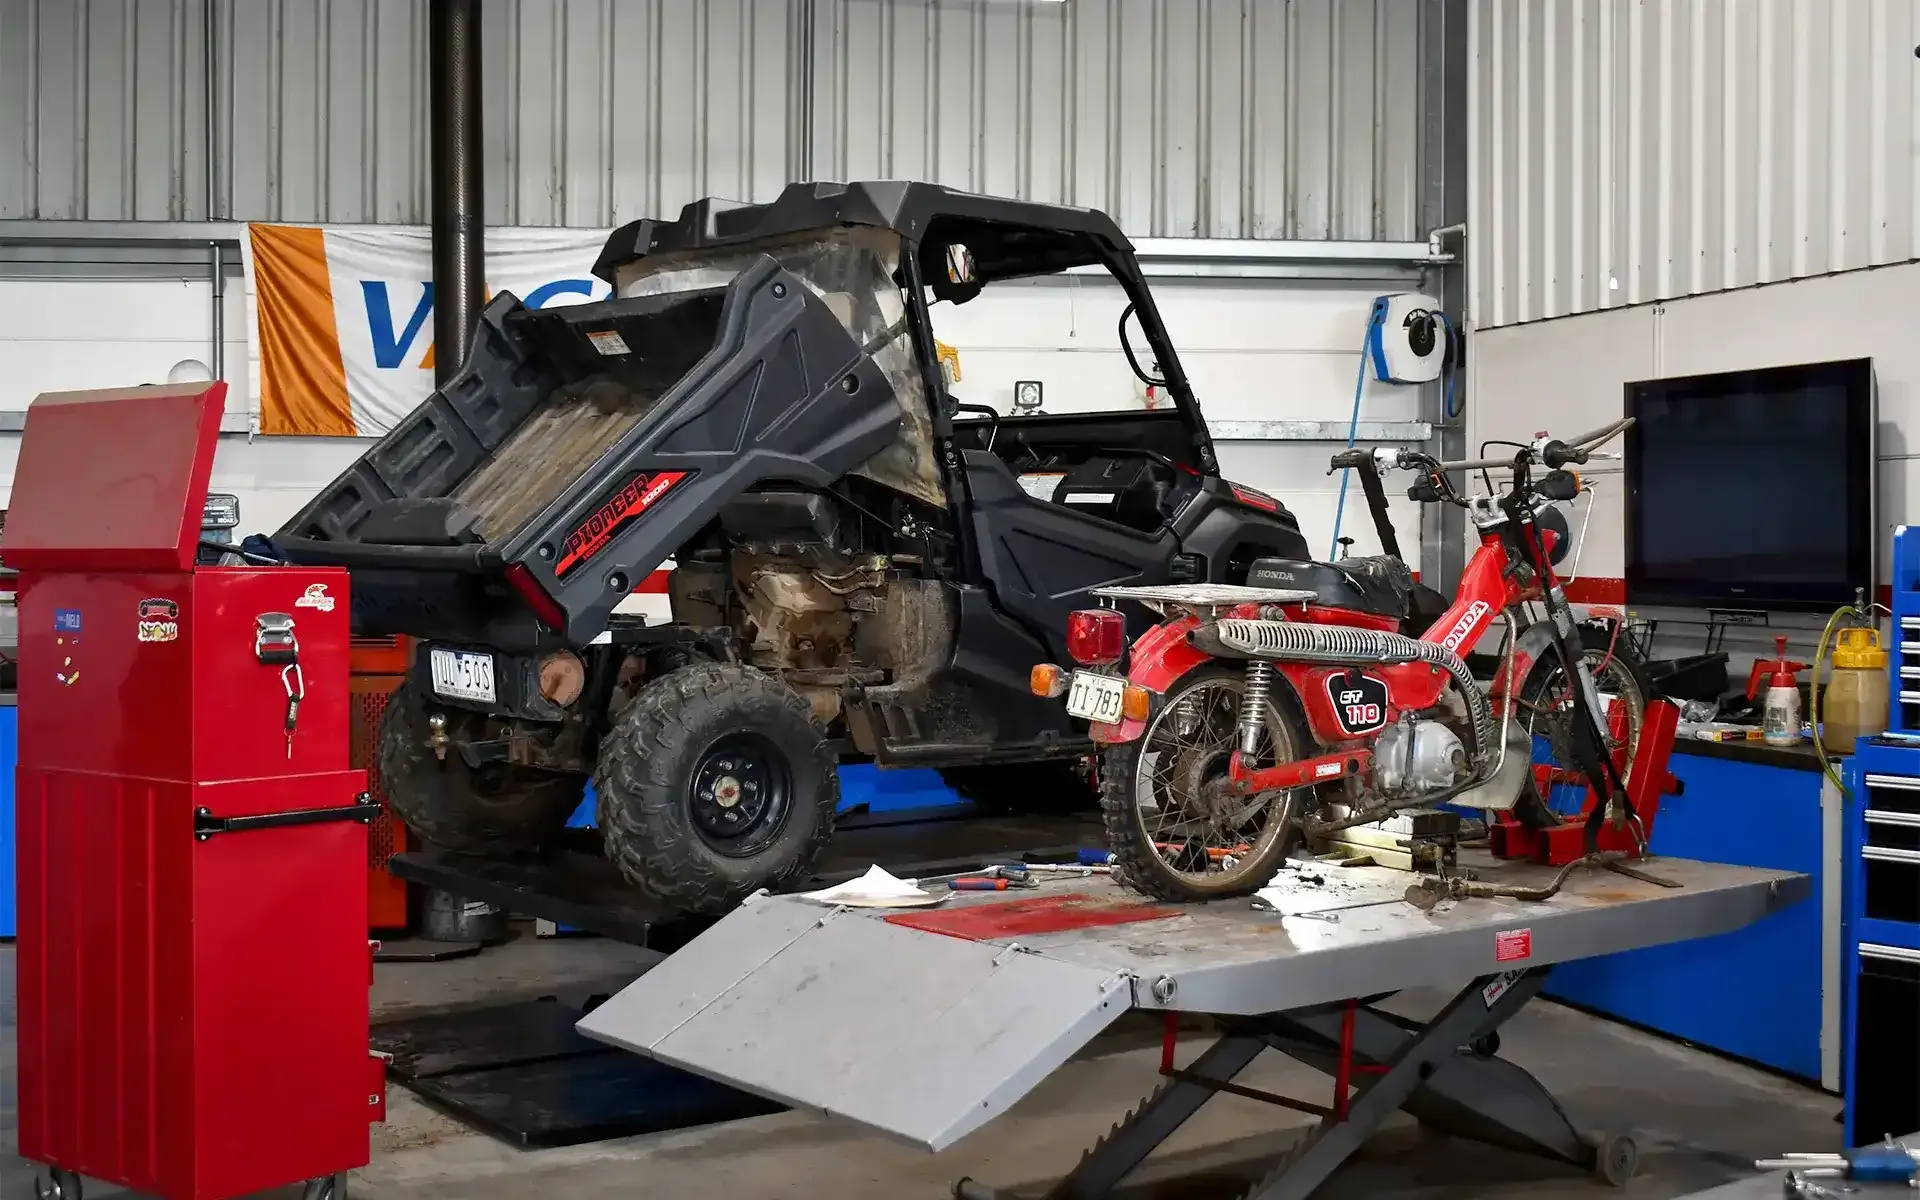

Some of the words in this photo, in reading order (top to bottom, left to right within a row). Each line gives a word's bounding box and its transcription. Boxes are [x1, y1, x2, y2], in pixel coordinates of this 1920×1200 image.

[566, 473, 649, 556] PIONEER
[641, 479, 670, 506] 1000
[1256, 569, 1295, 581] HONDA
[1092, 677, 1107, 687] VIC
[1340, 690, 1363, 704] CT
[1346, 704, 1380, 725] 110
